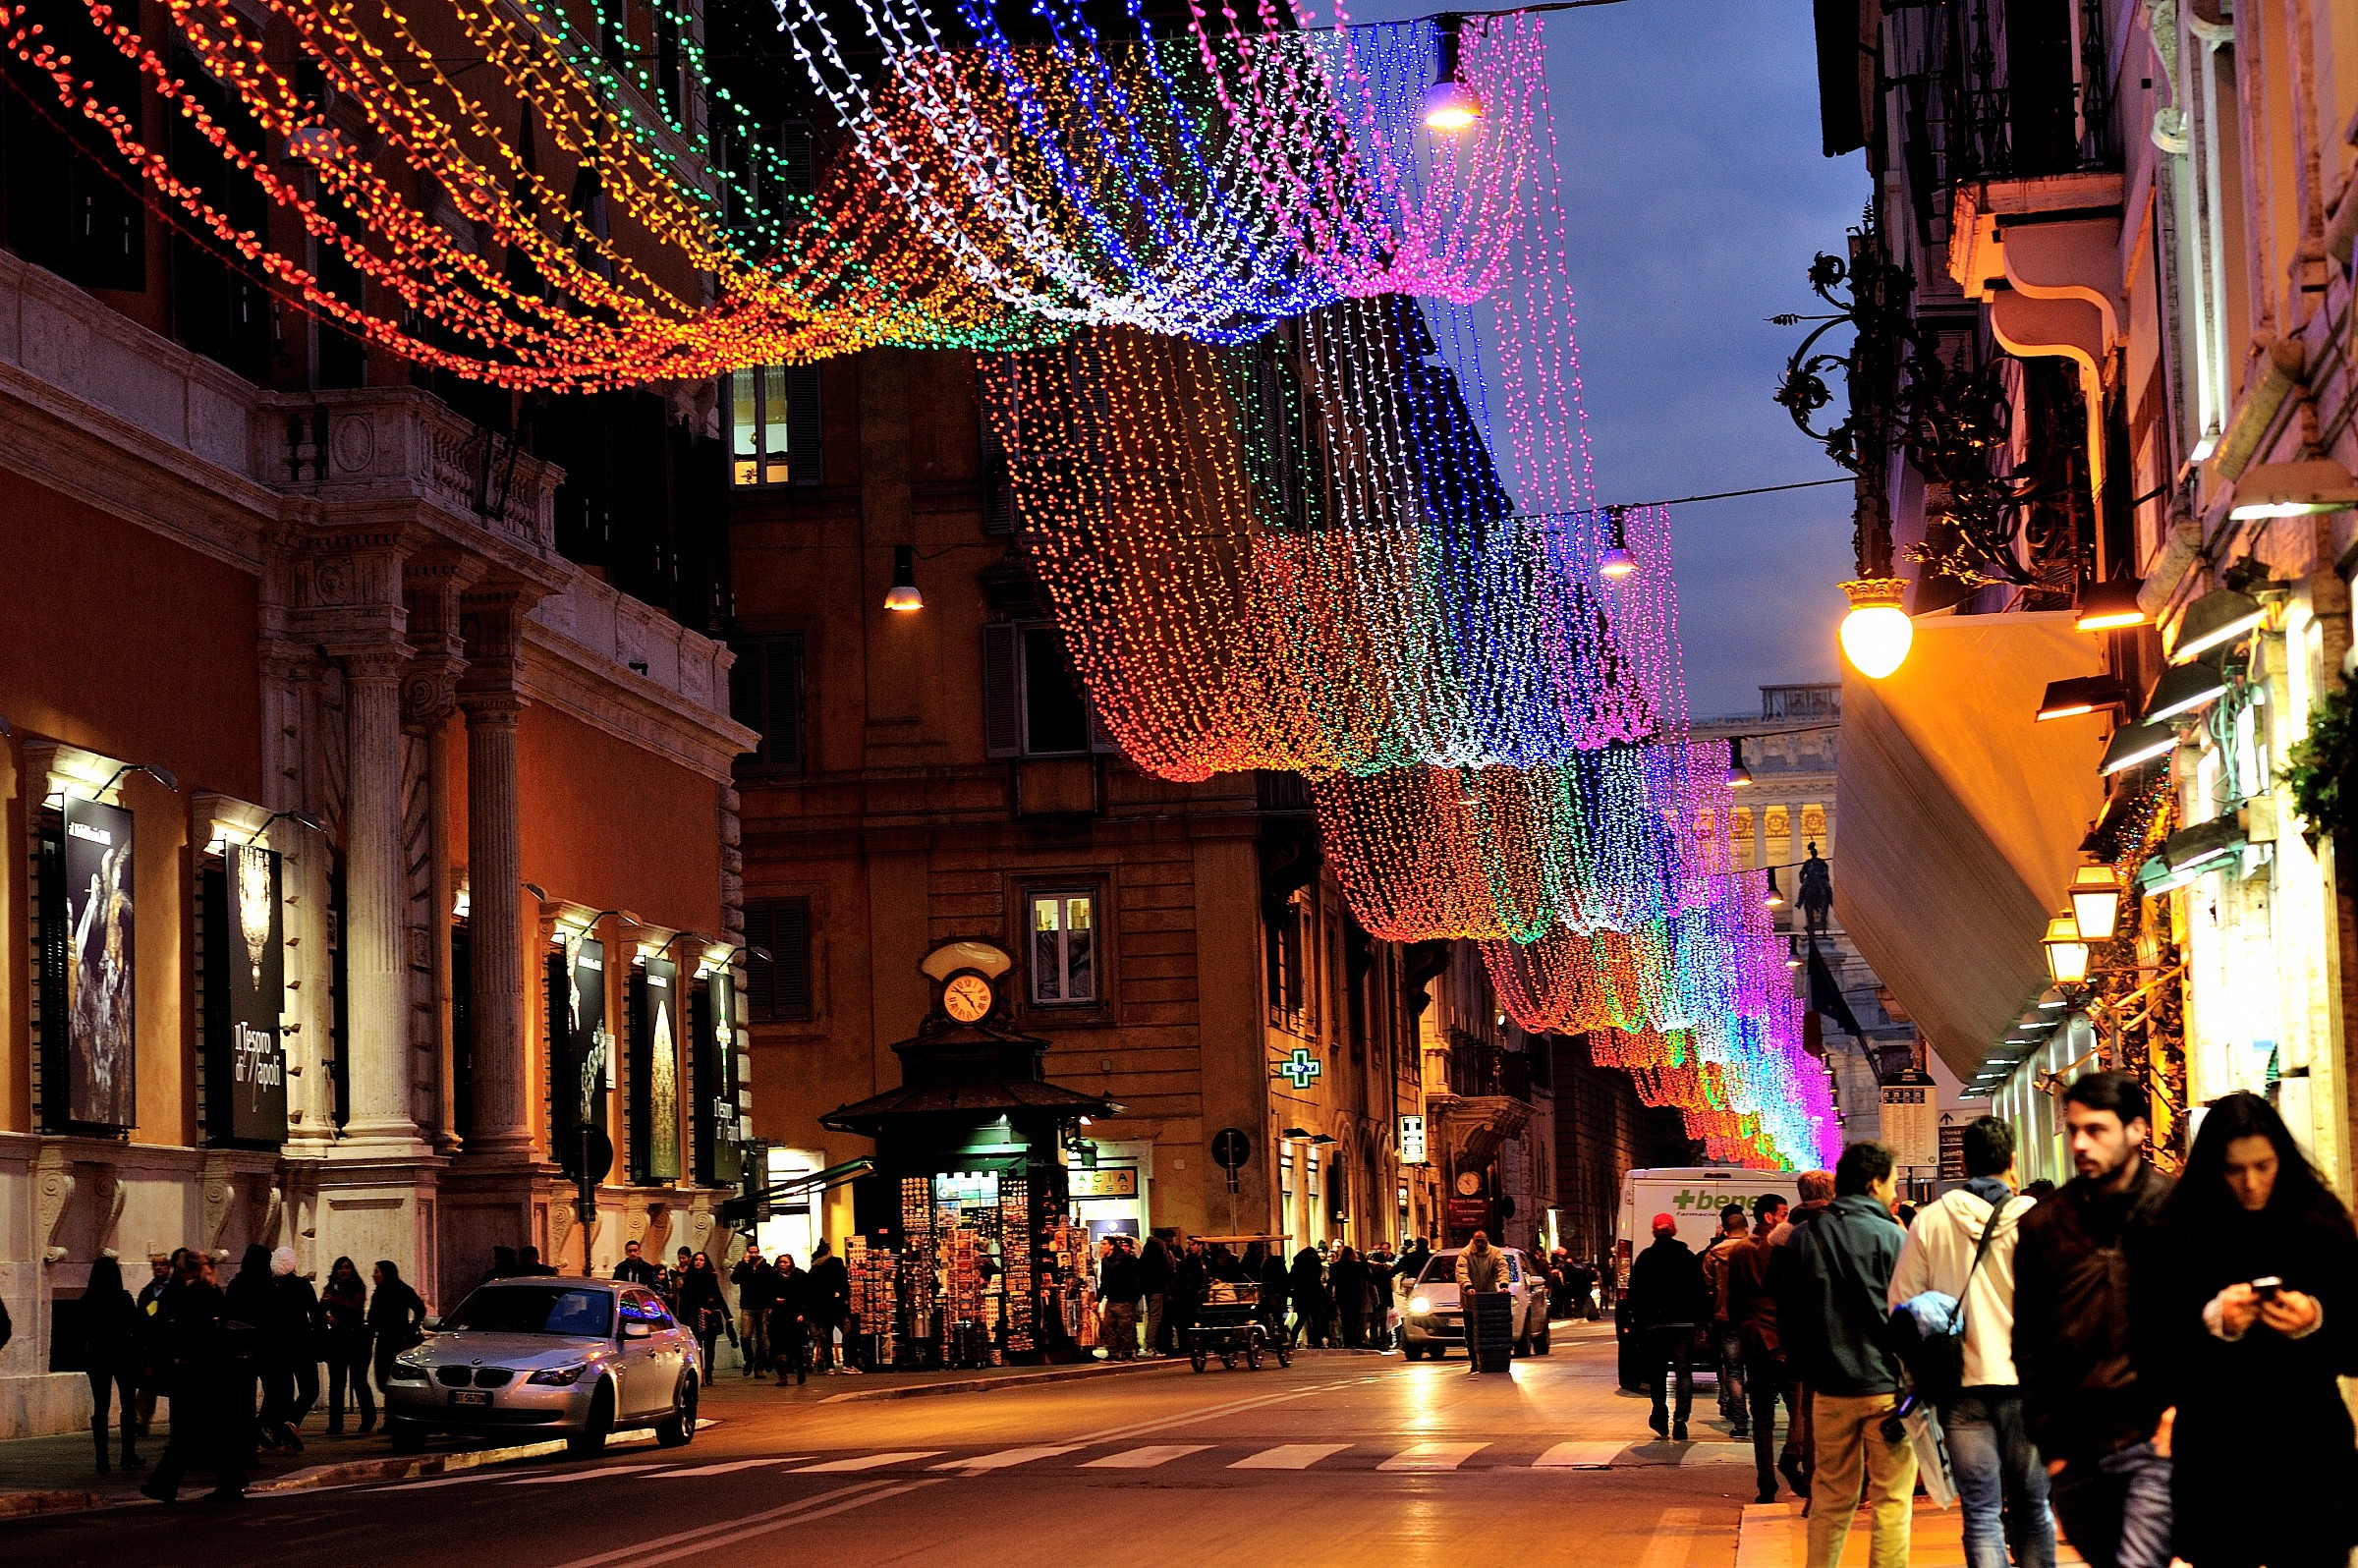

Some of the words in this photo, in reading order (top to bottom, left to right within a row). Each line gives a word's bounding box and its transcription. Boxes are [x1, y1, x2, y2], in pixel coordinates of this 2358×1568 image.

[241, 1021, 271, 1054] Tesoro
[248, 1051, 281, 1103] Napoli
[1942, 1149, 1964, 1158] panth
[1068, 1172, 1129, 1185] ACIA
[1077, 1184, 1129, 1193] ORSO
